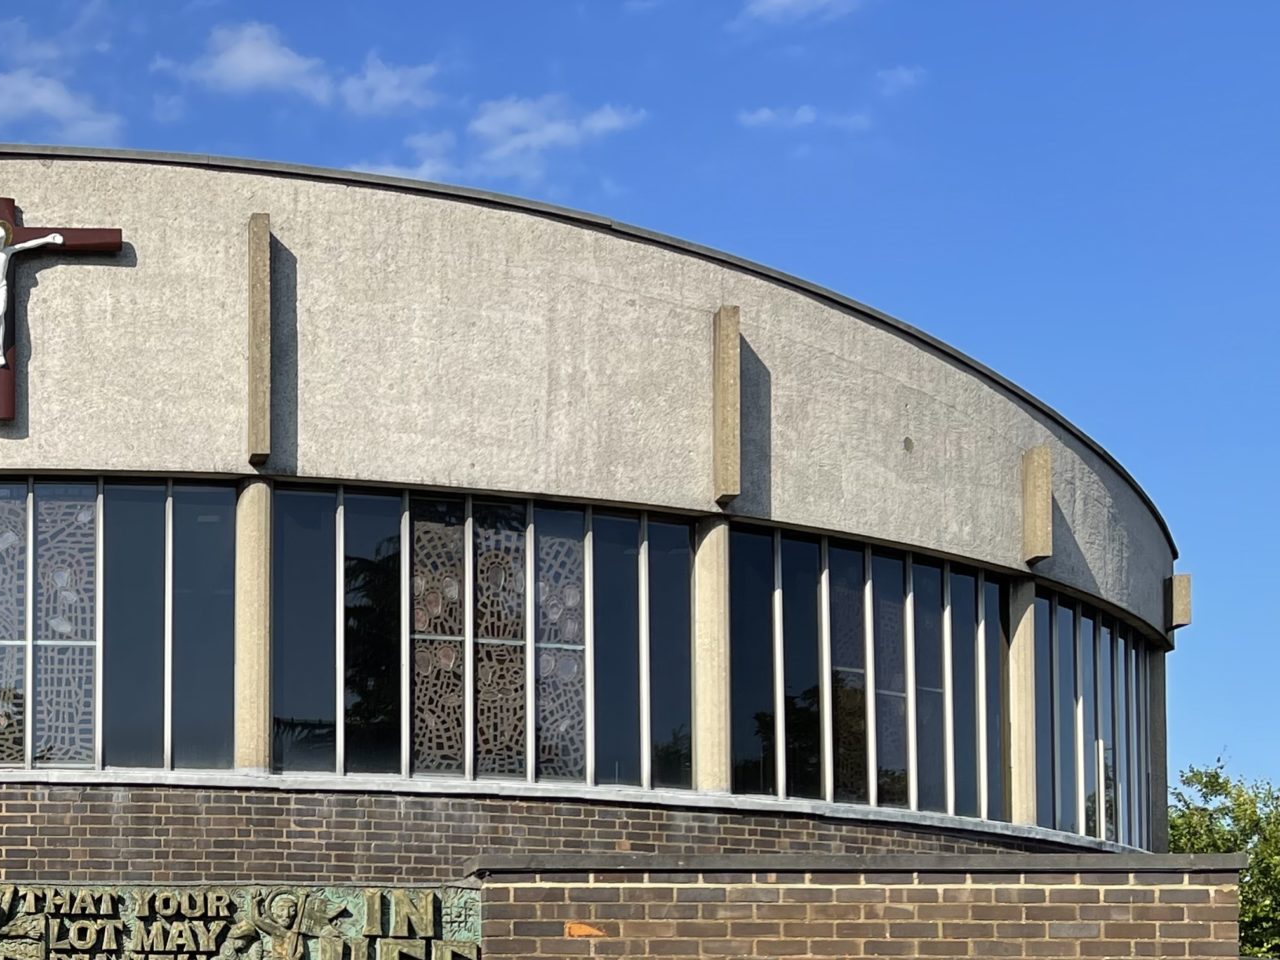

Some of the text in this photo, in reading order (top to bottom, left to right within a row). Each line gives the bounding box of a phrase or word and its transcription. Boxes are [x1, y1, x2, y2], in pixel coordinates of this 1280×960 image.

[19, 886, 231, 917] THAT YOUR
[362, 888, 435, 937] IN
[49, 918, 228, 952] LOT MAY
